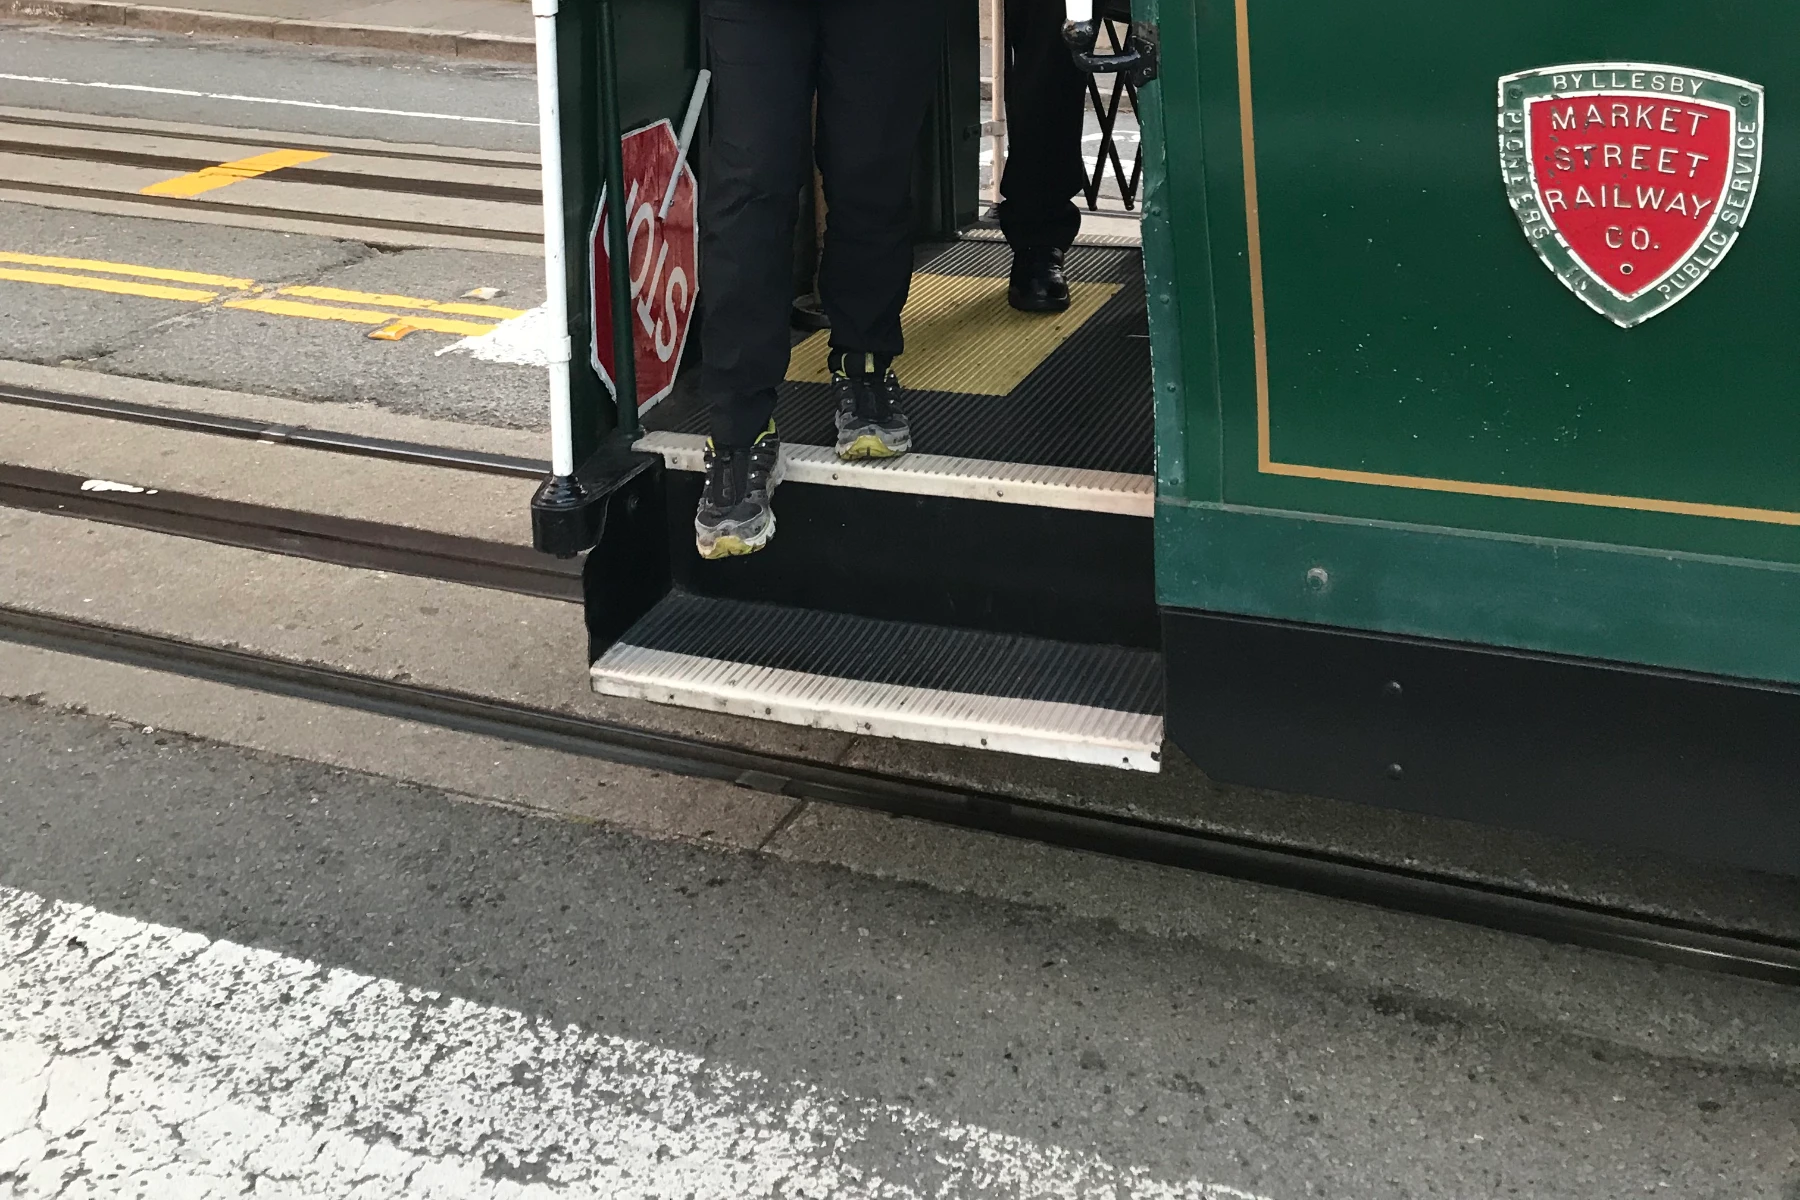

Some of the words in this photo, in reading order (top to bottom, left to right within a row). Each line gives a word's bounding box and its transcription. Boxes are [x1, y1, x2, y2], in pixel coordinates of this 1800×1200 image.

[1552, 72, 1705, 96] BYLLESBY
[1552, 103, 1709, 137] MARKET
[1554, 144, 1709, 179] STREET
[1544, 184, 1712, 220] RAILWAY
[1657, 230, 1728, 300] PUBLIC
[1721, 120, 1757, 225] SERVICE
[1605, 226, 1661, 251] CO.
